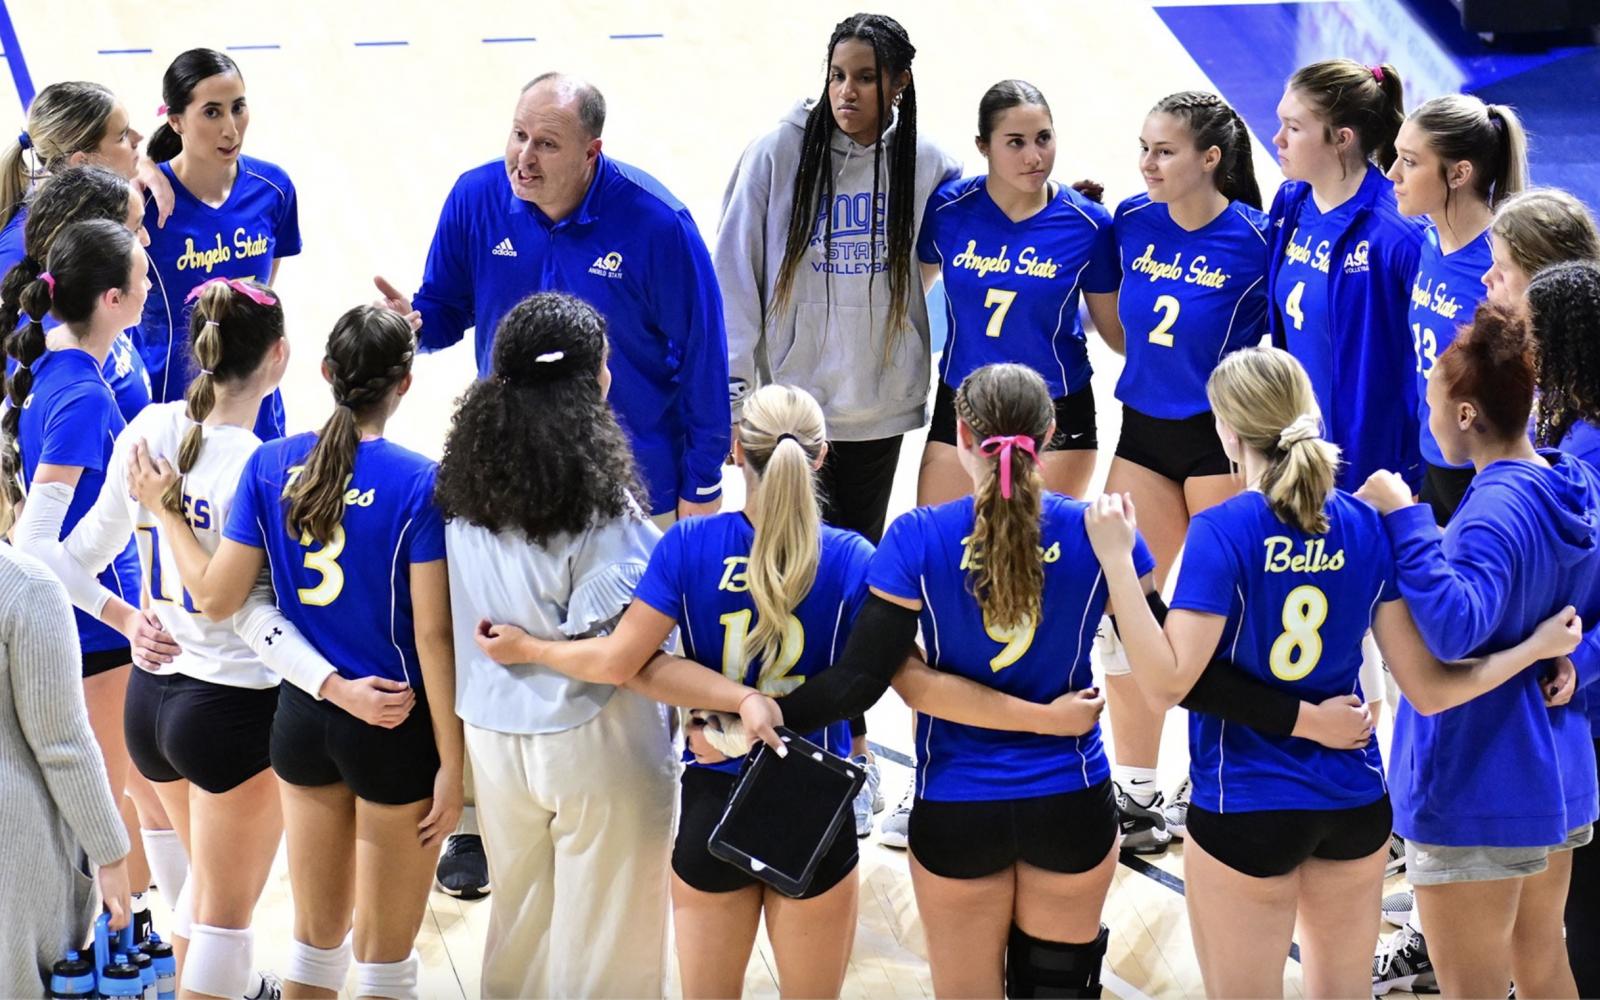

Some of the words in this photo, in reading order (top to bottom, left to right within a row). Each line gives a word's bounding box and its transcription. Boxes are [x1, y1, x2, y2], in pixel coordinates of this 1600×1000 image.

[177, 238, 230, 273] Angelo
[234, 227, 267, 259] State
[492, 249, 517, 257] adidas
[811, 261, 889, 275] VOLLEYBA
[826, 241, 885, 260] STAT
[953, 239, 1011, 278] Angelo
[1015, 246, 1058, 279] State
[1132, 244, 1183, 282] Angelo
[1184, 255, 1226, 289] State
[1310, 240, 1331, 274] Sta
[588, 267, 607, 277] ANGELO
[608, 271, 623, 279] STATE
[984, 288, 1018, 338] 7
[1148, 294, 1181, 348] 2
[1286, 281, 1306, 331] 4
[1431, 282, 1458, 319] State
[1412, 323, 1437, 380] 13
[297, 522, 346, 607] 3
[1264, 535, 1345, 573] Belles
[719, 608, 806, 698] 12
[983, 596, 1038, 673] 9
[1269, 584, 1329, 682] 8
